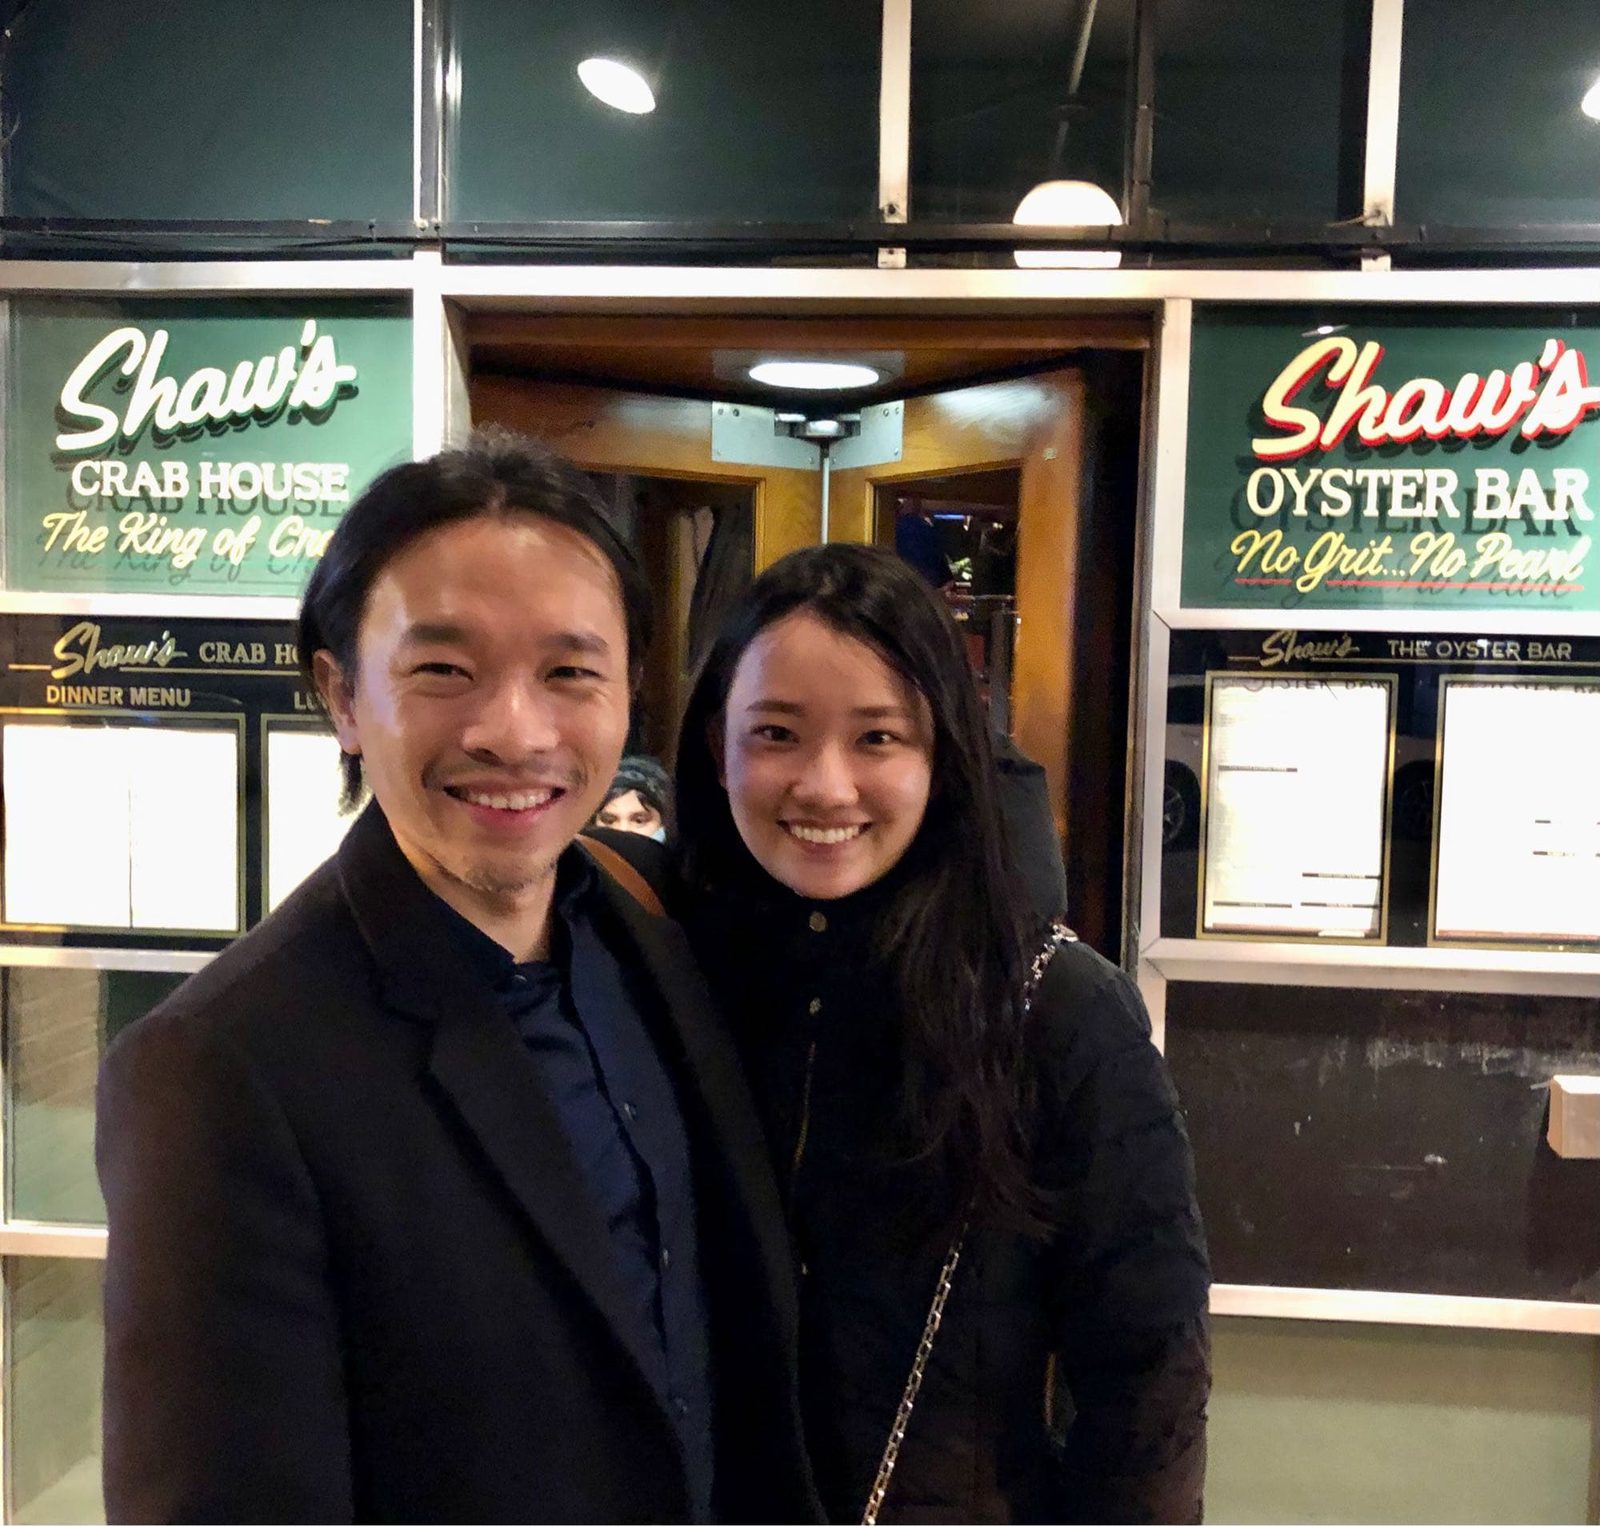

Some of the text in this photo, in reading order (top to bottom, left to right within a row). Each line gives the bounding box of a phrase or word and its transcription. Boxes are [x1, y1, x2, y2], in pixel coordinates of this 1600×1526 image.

[56, 320, 357, 450] Shaw's
[1252, 336, 1600, 461] Shaw's
[71, 460, 350, 502] CRAB HOUSE
[1246, 467, 1595, 521] OYSTER BAR
[42, 511, 337, 569] The King of Cra
[1230, 529, 1299, 575] No
[1409, 531, 1467, 577] No
[1470, 532, 1592, 582] Pearl
[51, 621, 188, 680] Shaw's
[199, 641, 267, 664] CRAB
[1387, 639, 1428, 658] THE
[1435, 640, 1521, 662] OYSTER
[1528, 642, 1572, 661] BAR
[46, 685, 192, 708] DINNER MENU
